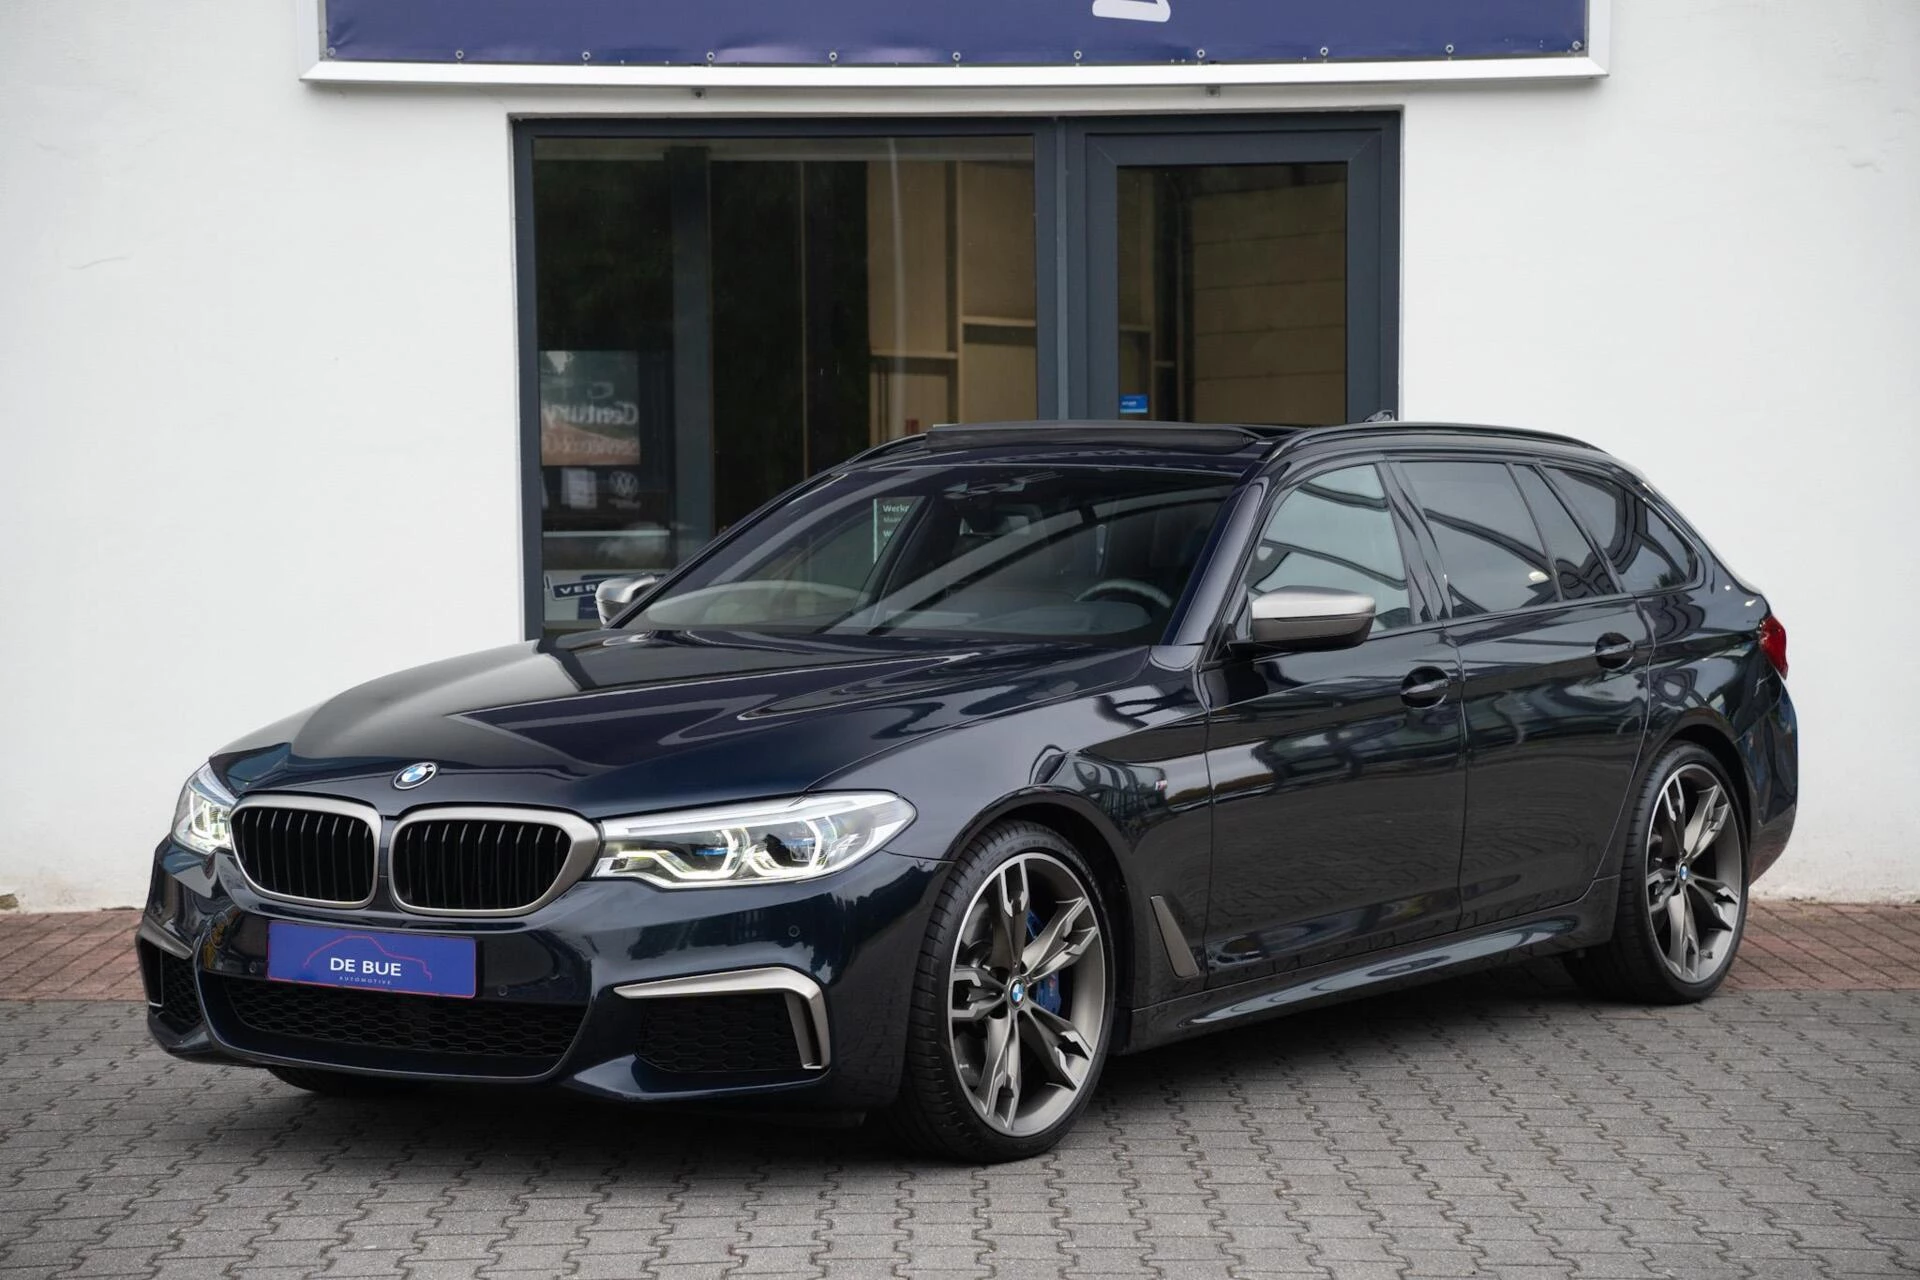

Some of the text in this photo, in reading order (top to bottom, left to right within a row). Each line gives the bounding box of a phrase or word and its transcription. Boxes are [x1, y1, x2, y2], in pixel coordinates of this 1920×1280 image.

[330, 957, 402, 977] DE BUE
[339, 976, 392, 985] AUTOMOTIVE
